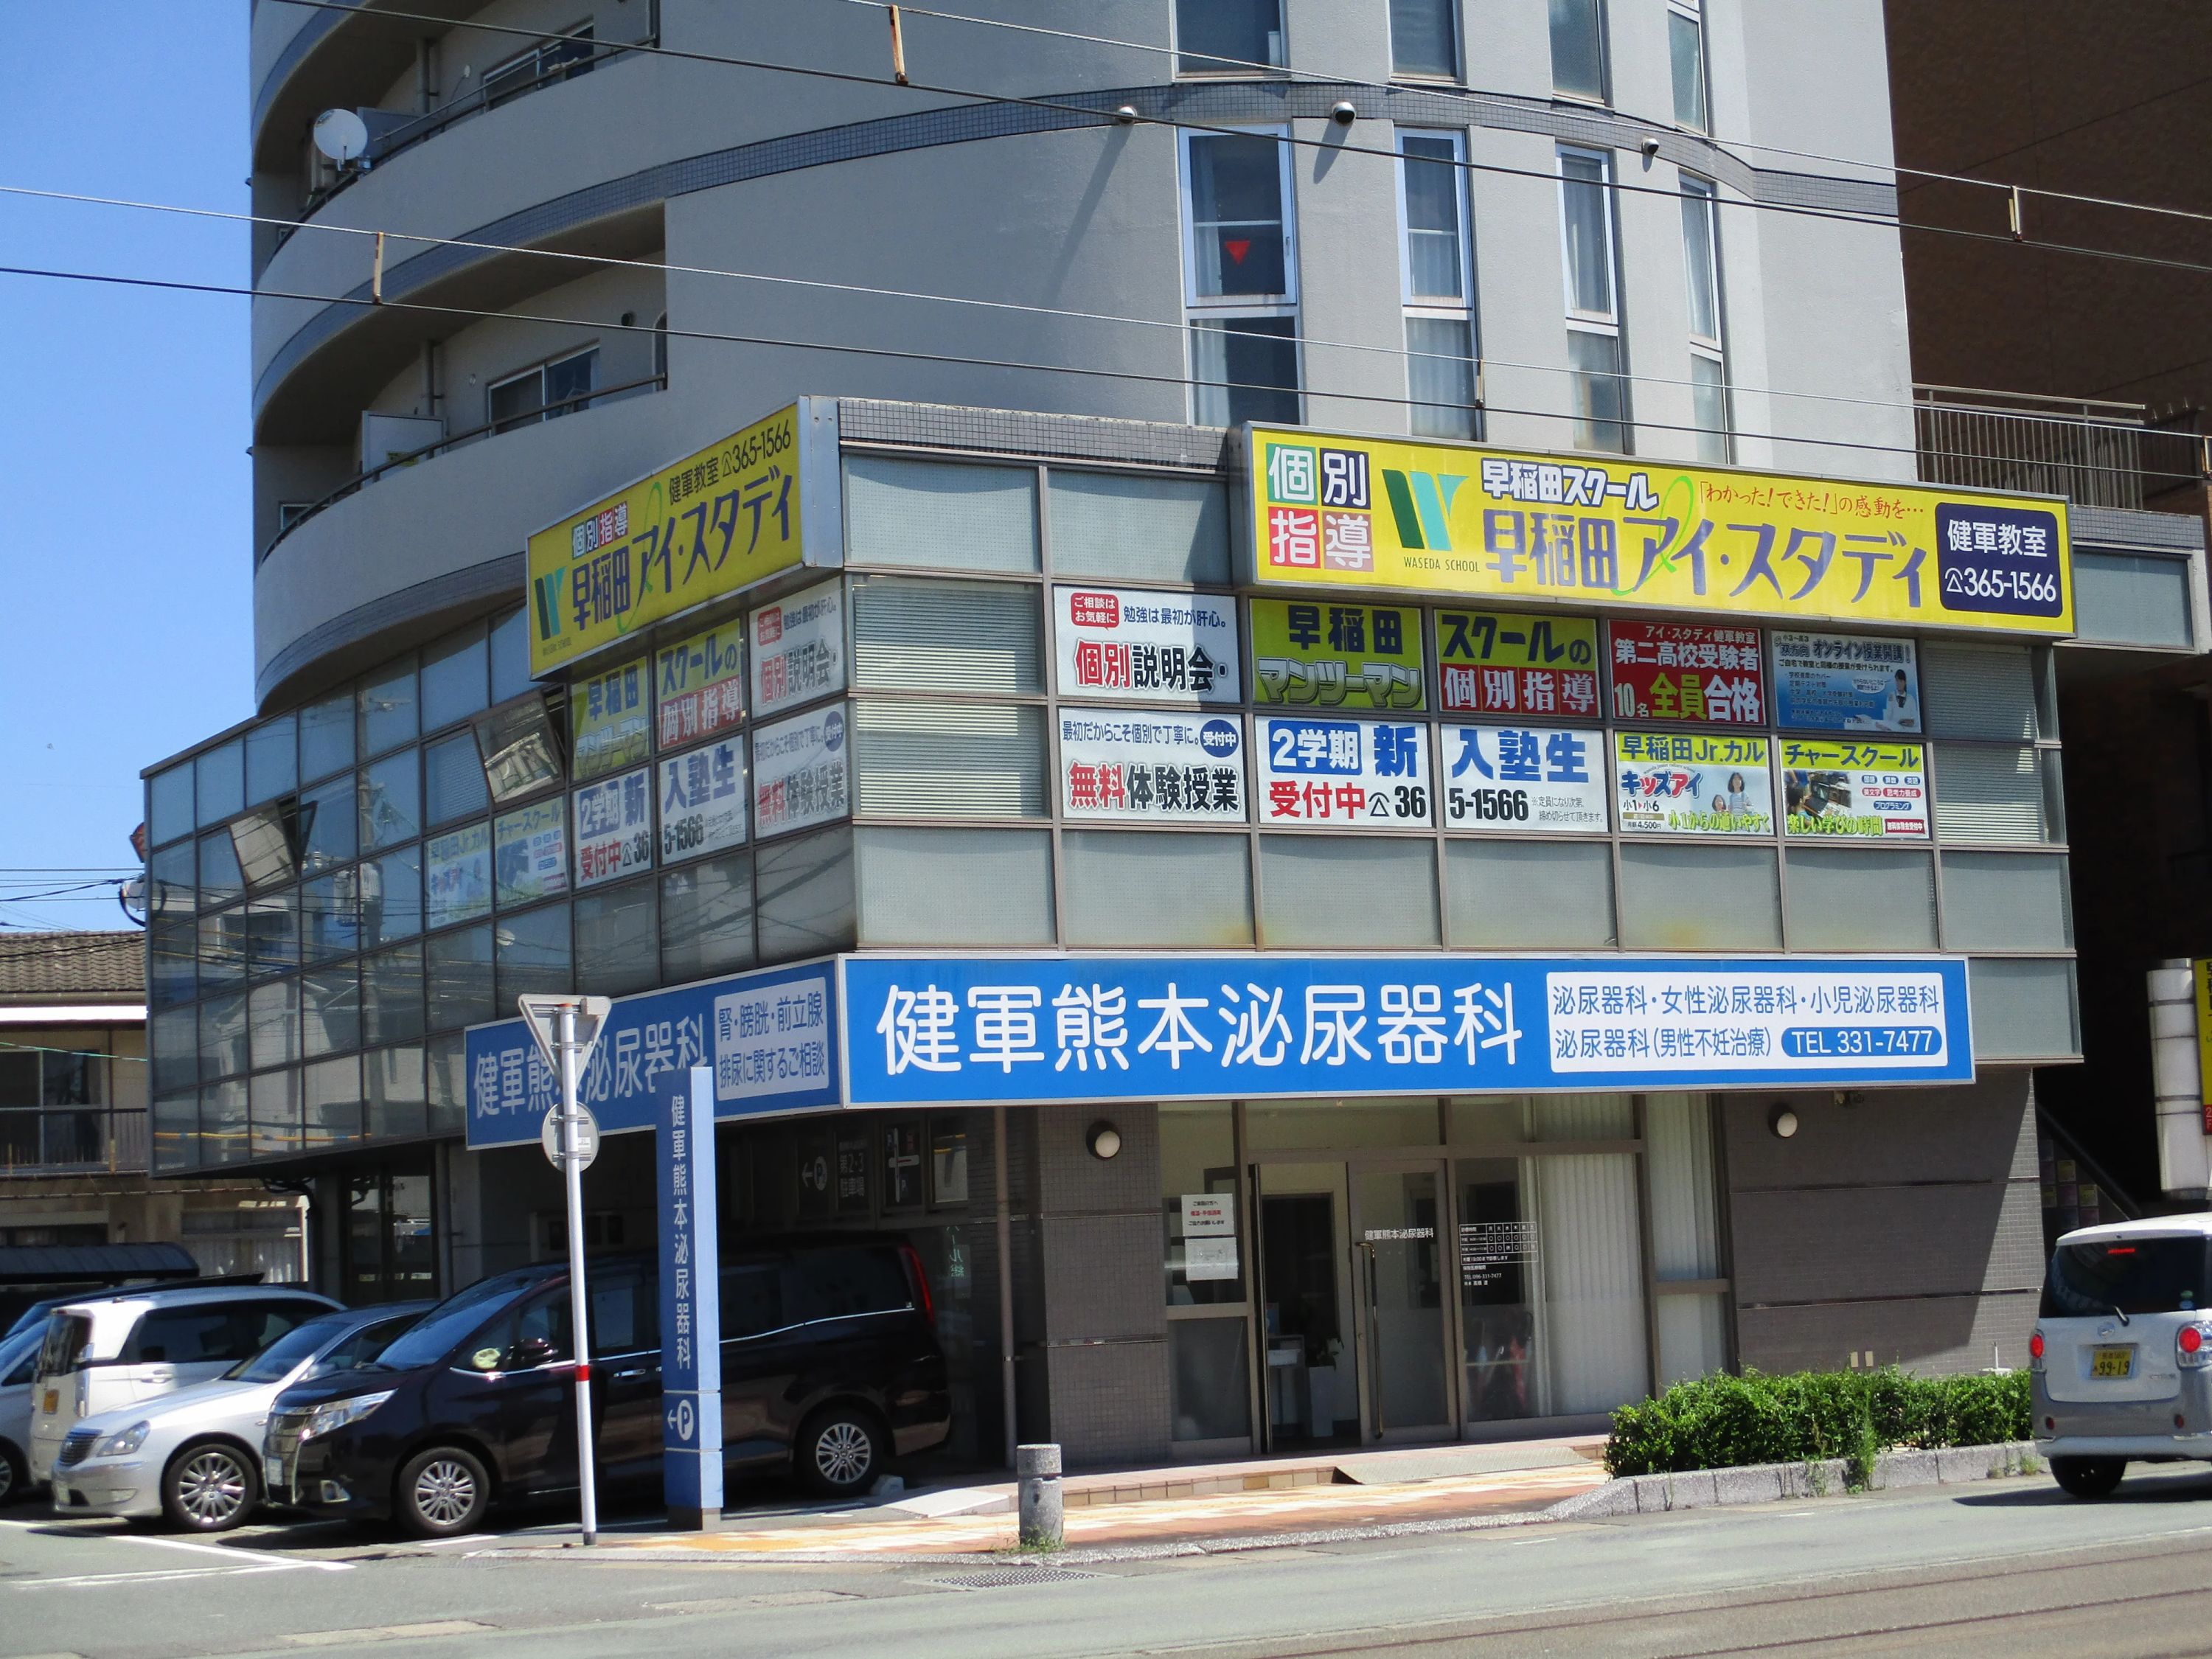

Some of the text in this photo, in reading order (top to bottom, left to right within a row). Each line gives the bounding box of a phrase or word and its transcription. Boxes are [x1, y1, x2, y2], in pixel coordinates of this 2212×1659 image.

[669, 420, 790, 506] 健軍教室 365-1566
[1268, 445, 1368, 507] 個別
[1481, 458, 1659, 512] 早稲田スクール
[572, 501, 627, 559] 個別指導
[572, 465, 793, 631] 早稲田アイ・スタディ
[1270, 510, 1371, 568] 指導
[1948, 519, 2047, 557] 健軍教室
[1404, 557, 1480, 573] WASEDA SCHOOL
[1484, 509, 1927, 608] 早稲田アイ・スタディ
[1074, 597, 1116, 609] ご相談は
[1964, 567, 2056, 602] 365-1566
[1075, 611, 1116, 624] お気軽に
[1123, 605, 1225, 627] 勉強は最初が肝心。
[1288, 605, 1403, 655] 早稲田
[1441, 613, 1592, 664] スクールの
[1646, 626, 1756, 644] アイ・スタディ健軍教室
[660, 633, 737, 696] スクールの
[1614, 638, 1759, 672] 第二高校受験者
[1257, 657, 1422, 708] マンツーマン
[1444, 667, 1594, 713] 個別指導
[663, 679, 740, 745] 個別指導
[1062, 720, 1199, 745] 最初だからこそ個別で丁寧に。
[1203, 731, 1237, 748] 受付中
[1272, 725, 1417, 777] 2学期 新
[1452, 728, 1589, 783] 入塾生
[1622, 736, 1764, 762] 早稲田Jr.カル
[1785, 743, 1919, 768] チャースクール
[665, 744, 736, 814] 入塾生
[1069, 761, 1239, 812] 無料体験授業
[1269, 780, 1426, 819] 受付中 36
[1621, 770, 1703, 798] キッズアイ
[581, 790, 619, 834] 2学期
[1449, 787, 1529, 821] 5-1566
[1787, 815, 1883, 836] 楽しい学びの時間
[581, 830, 649, 880] 受付中 36
[719, 991, 824, 1042] 腎・膀胱・前立腺
[1553, 985, 1939, 1015] 泌尿器科・女性泌尿器科・小児泌尿器科
[877, 982, 1523, 1075] 健軍熊本泌尿器科
[1792, 1032, 1830, 1054] TEL
[1837, 1031, 1933, 1054] 331-7477
[474, 1013, 707, 1119] 健軍熊泌尿器科
[720, 1040, 825, 1088] 排尿に関するご相談
[671, 1094, 691, 1369] 健軍熊本泌尿器科
[1365, 1228, 1433, 1240] 健軍熊本泌尿器科
